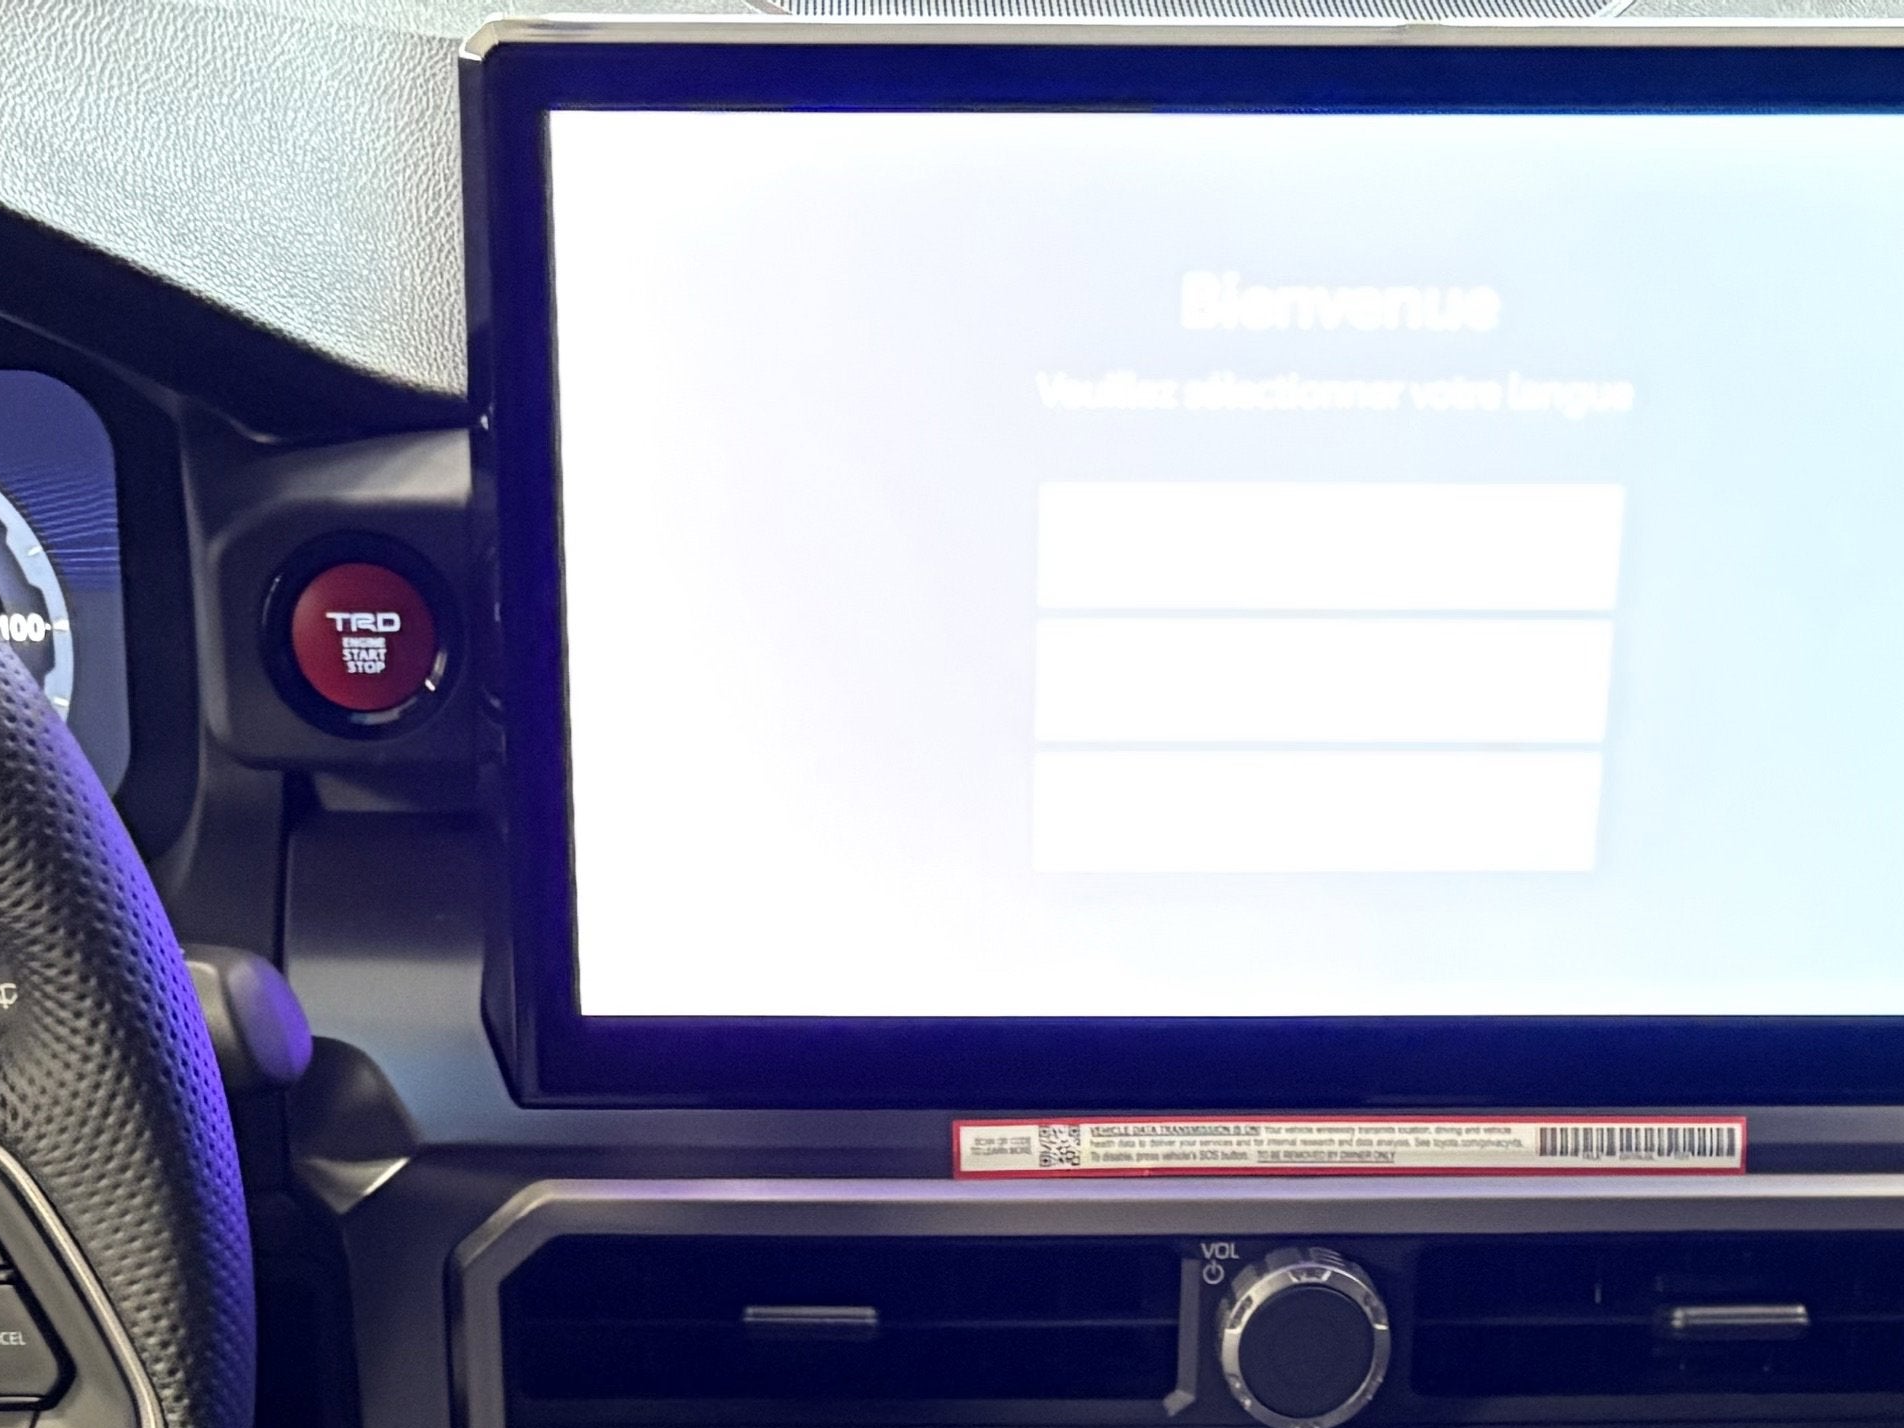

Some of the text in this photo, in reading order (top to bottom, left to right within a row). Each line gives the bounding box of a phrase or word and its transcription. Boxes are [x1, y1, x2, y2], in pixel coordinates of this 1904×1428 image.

[325, 612, 401, 632] TRD
[342, 648, 387, 661] START
[347, 661, 386, 674] STOP
[1201, 1242, 1239, 1259] VOL
